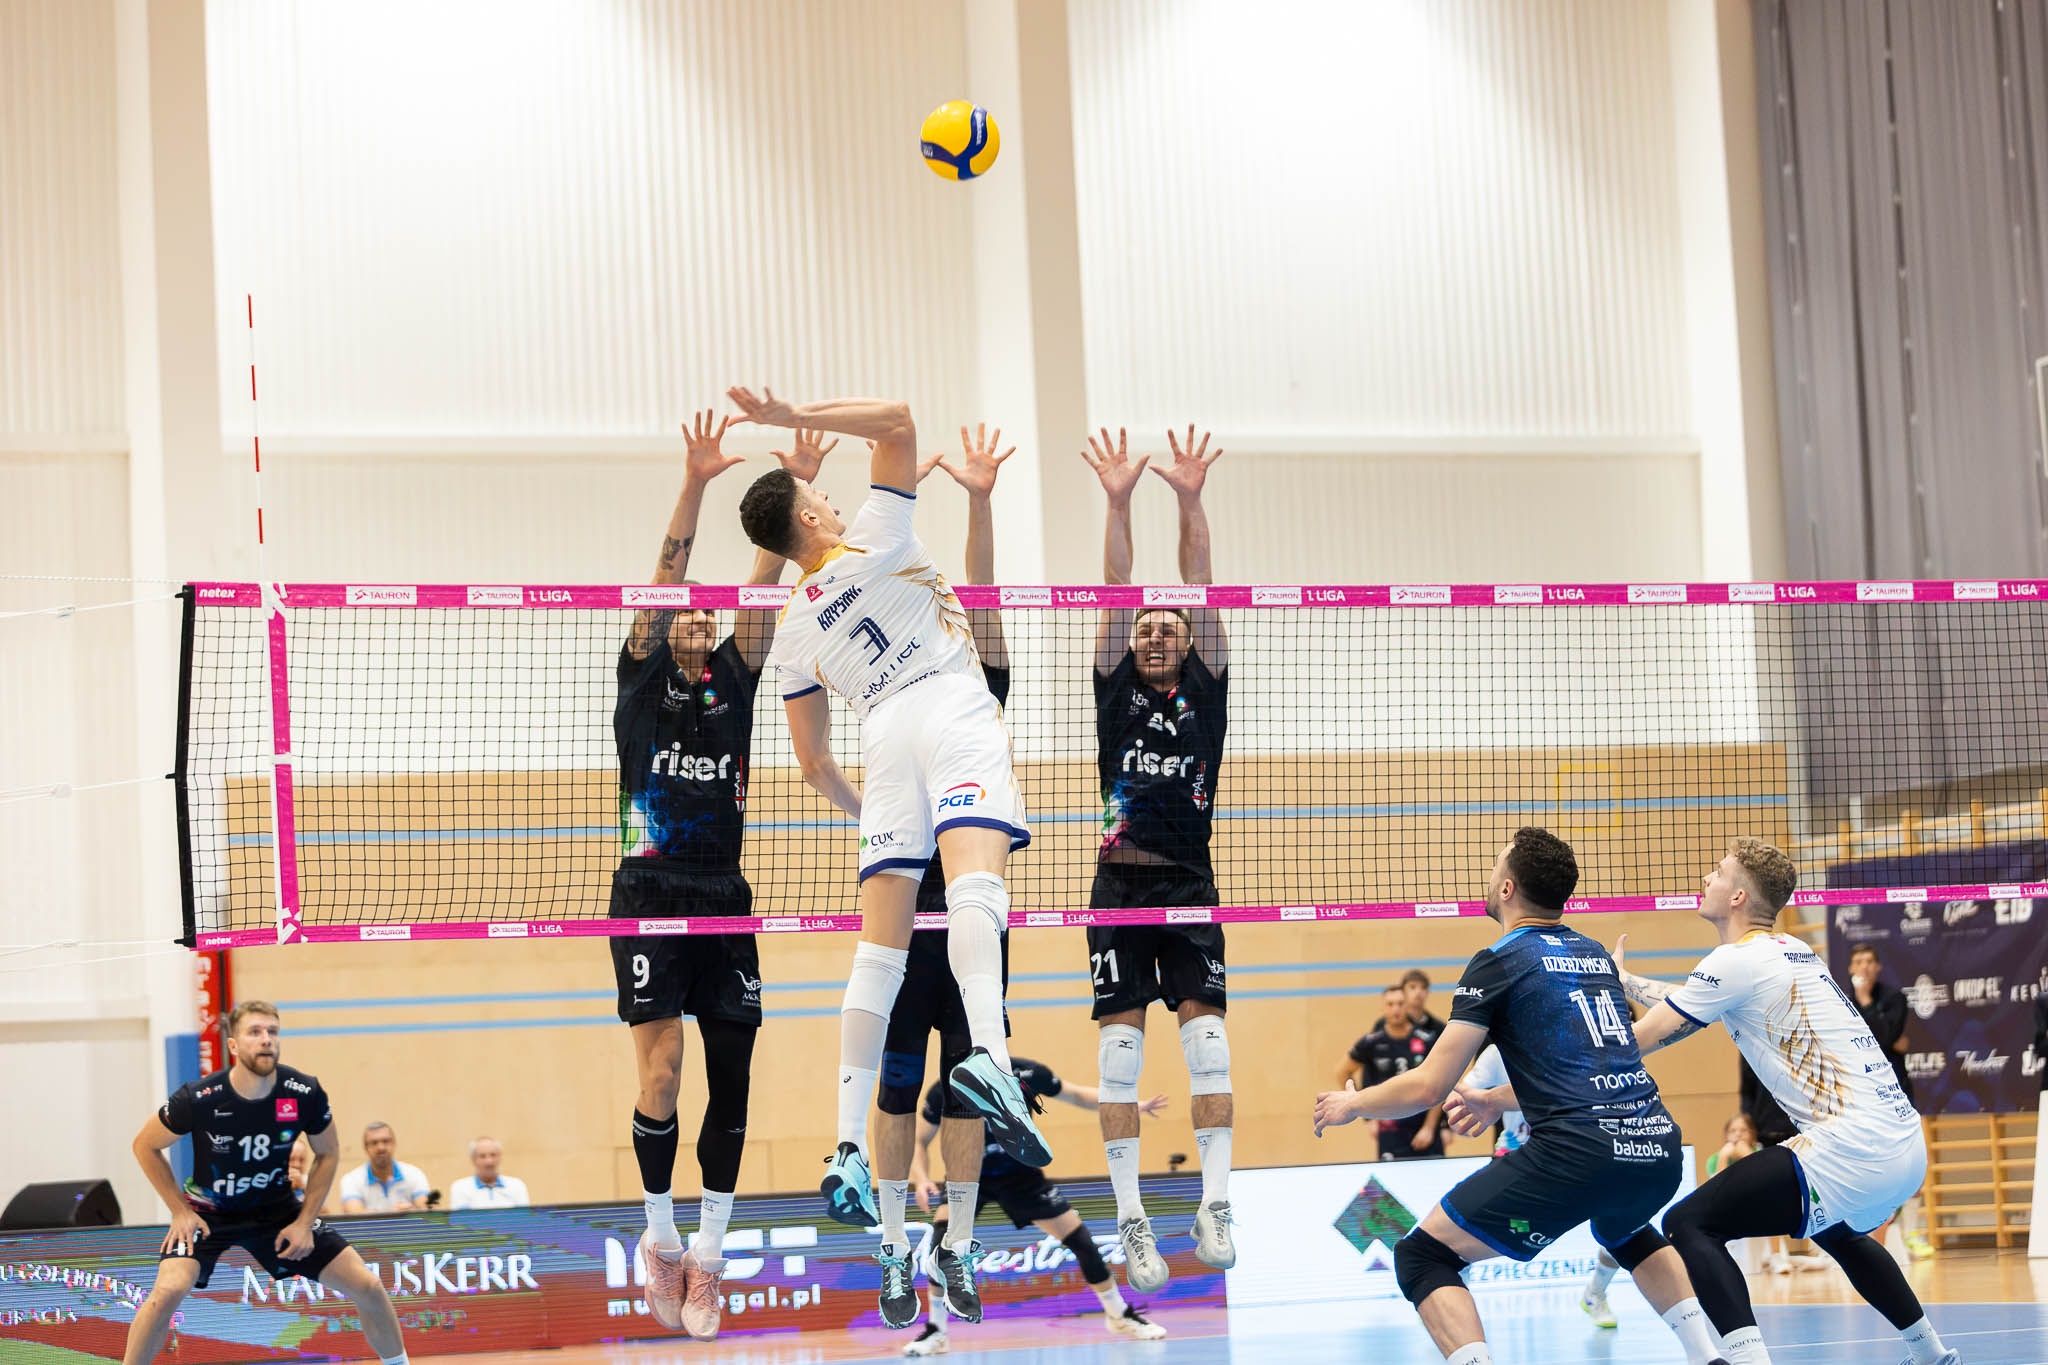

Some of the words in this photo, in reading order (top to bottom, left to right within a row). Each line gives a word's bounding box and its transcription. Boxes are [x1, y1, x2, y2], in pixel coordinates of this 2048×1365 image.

[199, 587, 236, 599] netex
[370, 591, 411, 600] TAURON
[1164, 591, 1201, 600] TAURON
[1268, 592, 1299, 600] TAURON
[1315, 590, 1345, 601] LIGA
[1410, 591, 1445, 599] TAURON
[1510, 591, 1540, 599] TAURON
[1557, 589, 1584, 600] LIGA
[1647, 589, 1681, 598] TAURON
[1788, 587, 1816, 598] LIGA
[1875, 587, 1908, 595] TAURON
[2011, 585, 2037, 595] LIGA
[540, 591, 572, 602] LIGA
[644, 592, 683, 601] TAURON
[1067, 591, 1098, 602] LIGA
[651, 741, 731, 781] riser
[1122, 738, 1194, 778] riser
[938, 794, 976, 812] PGE
[871, 831, 893, 846] CUK
[2031, 887, 2048, 895] LIGA
[1569, 902, 1589, 910] LIGA
[1075, 914, 1095, 922] LIGA
[540, 925, 563, 933] LIGA
[812, 920, 834, 928] LIGA
[376, 928, 406, 936] TAURON
[205, 936, 232, 946] netex
[632, 953, 650, 989] 9
[1090, 949, 1120, 986] 21
[1455, 986, 1484, 998] ELIK
[1568, 989, 1629, 1048] 14
[283, 1077, 312, 1095] riser
[238, 1134, 271, 1161] 18
[1613, 1138, 1663, 1157] balzola
[213, 1168, 283, 1196] riser
[1467, 1259, 1597, 1282] EZPIECZENIA
